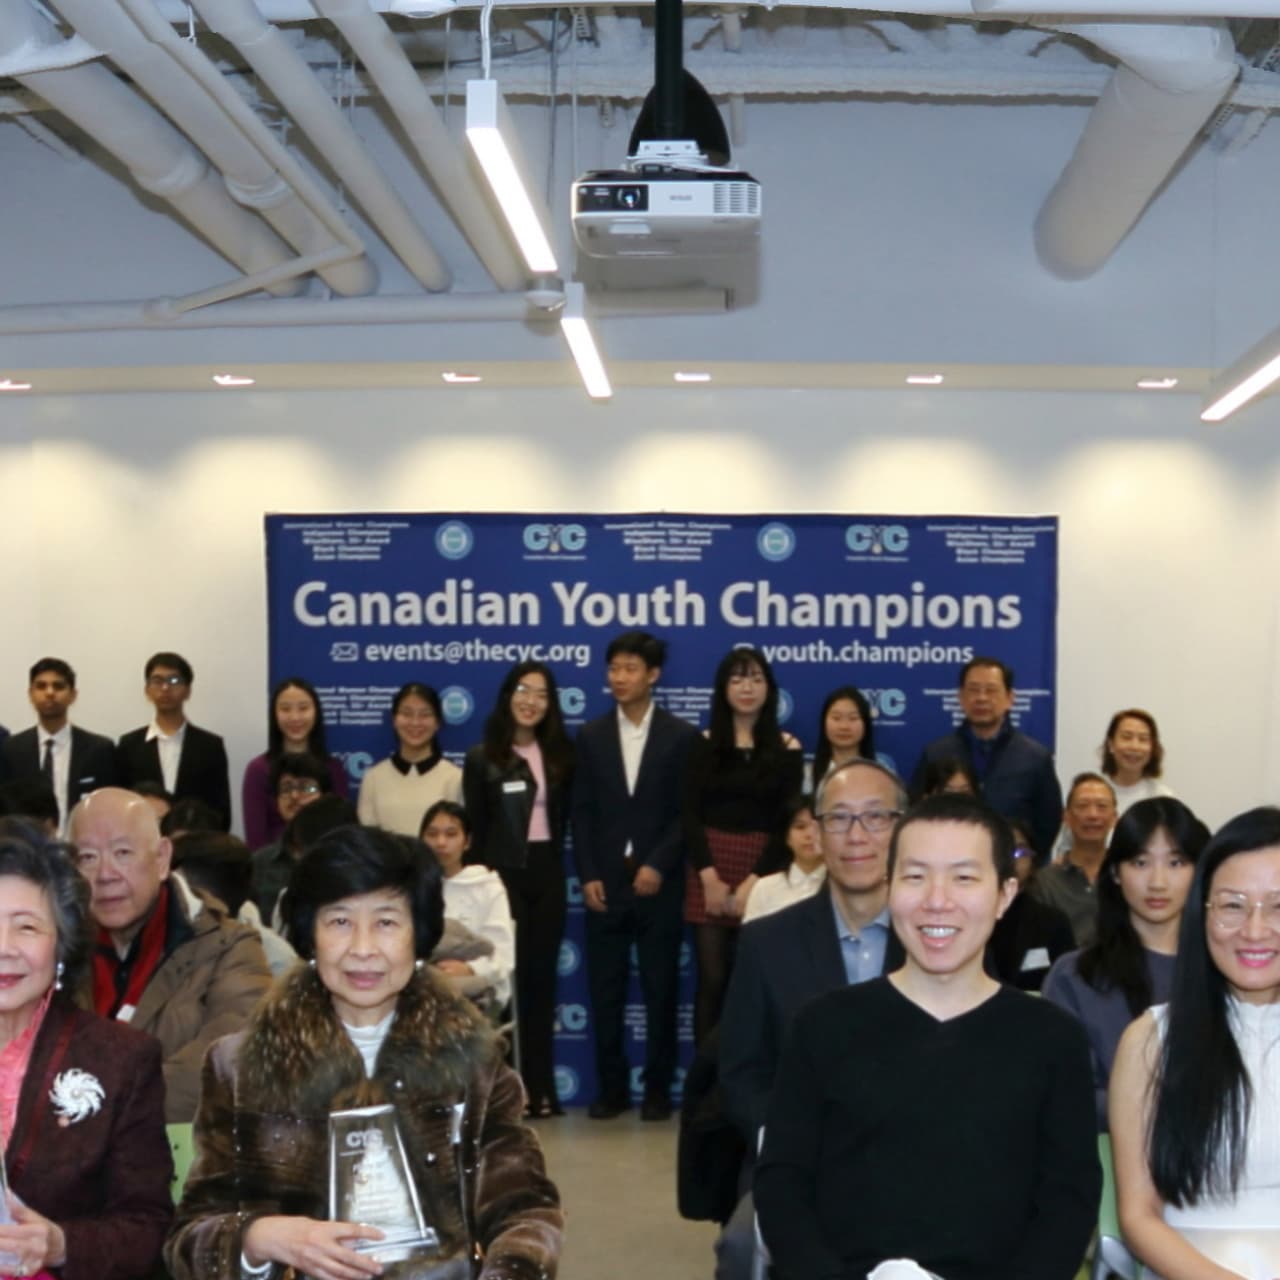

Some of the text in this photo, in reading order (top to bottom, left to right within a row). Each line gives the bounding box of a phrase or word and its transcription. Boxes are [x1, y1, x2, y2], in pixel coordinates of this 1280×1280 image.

[293, 578, 1022, 639] Canadian Youth Champions
[365, 638, 591, 667] events@thecyc.org
[762, 640, 974, 668] youth.champions
